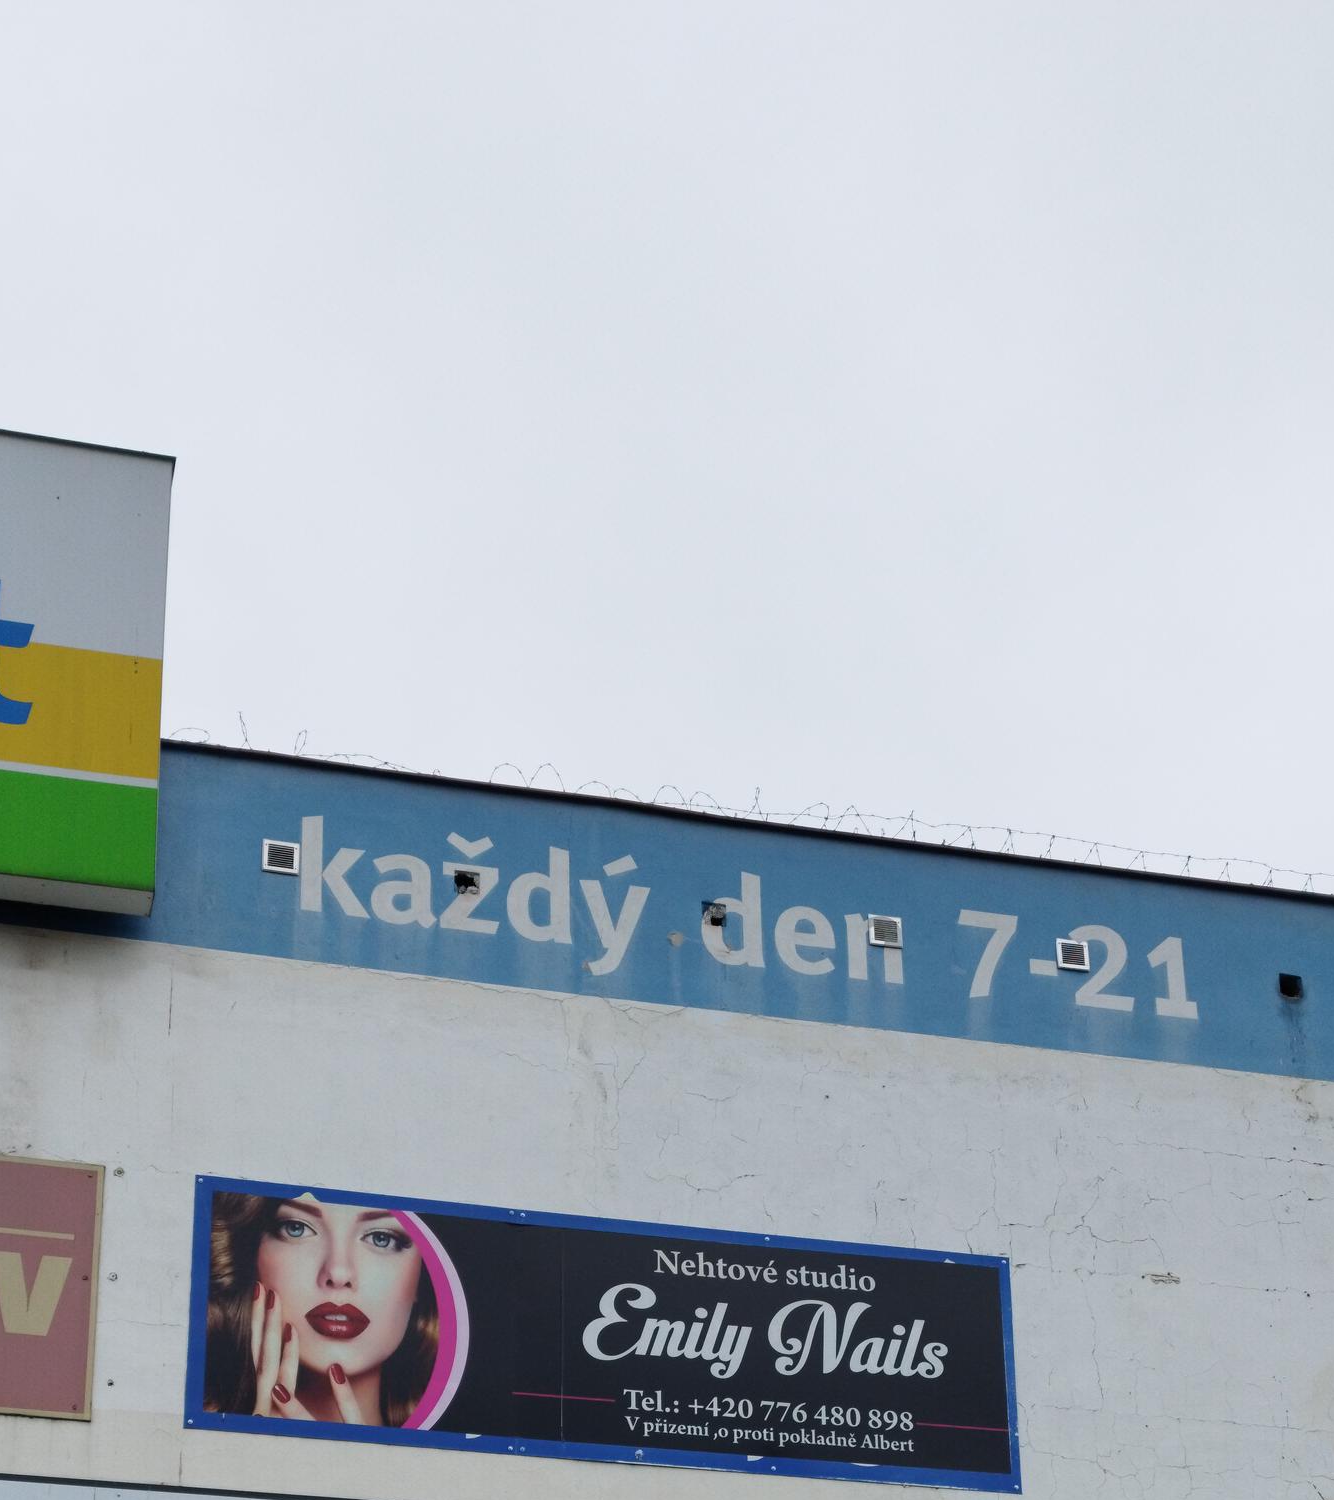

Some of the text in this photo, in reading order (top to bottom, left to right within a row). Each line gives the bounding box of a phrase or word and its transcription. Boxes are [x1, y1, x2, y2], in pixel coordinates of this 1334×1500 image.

[299, 815, 1200, 1020] každý den 7-21
[653, 1249, 877, 1293] Nehtové studio
[582, 1283, 949, 1379] Emily Nails
[623, 1388, 915, 1432] Tel.: +420 776 480 898
[624, 1416, 640, 1431] V
[643, 1417, 709, 1438] přizemí
[732, 1425, 775, 1444] proti
[778, 1427, 857, 1448] pokladně
[860, 1433, 915, 1452] Albert
